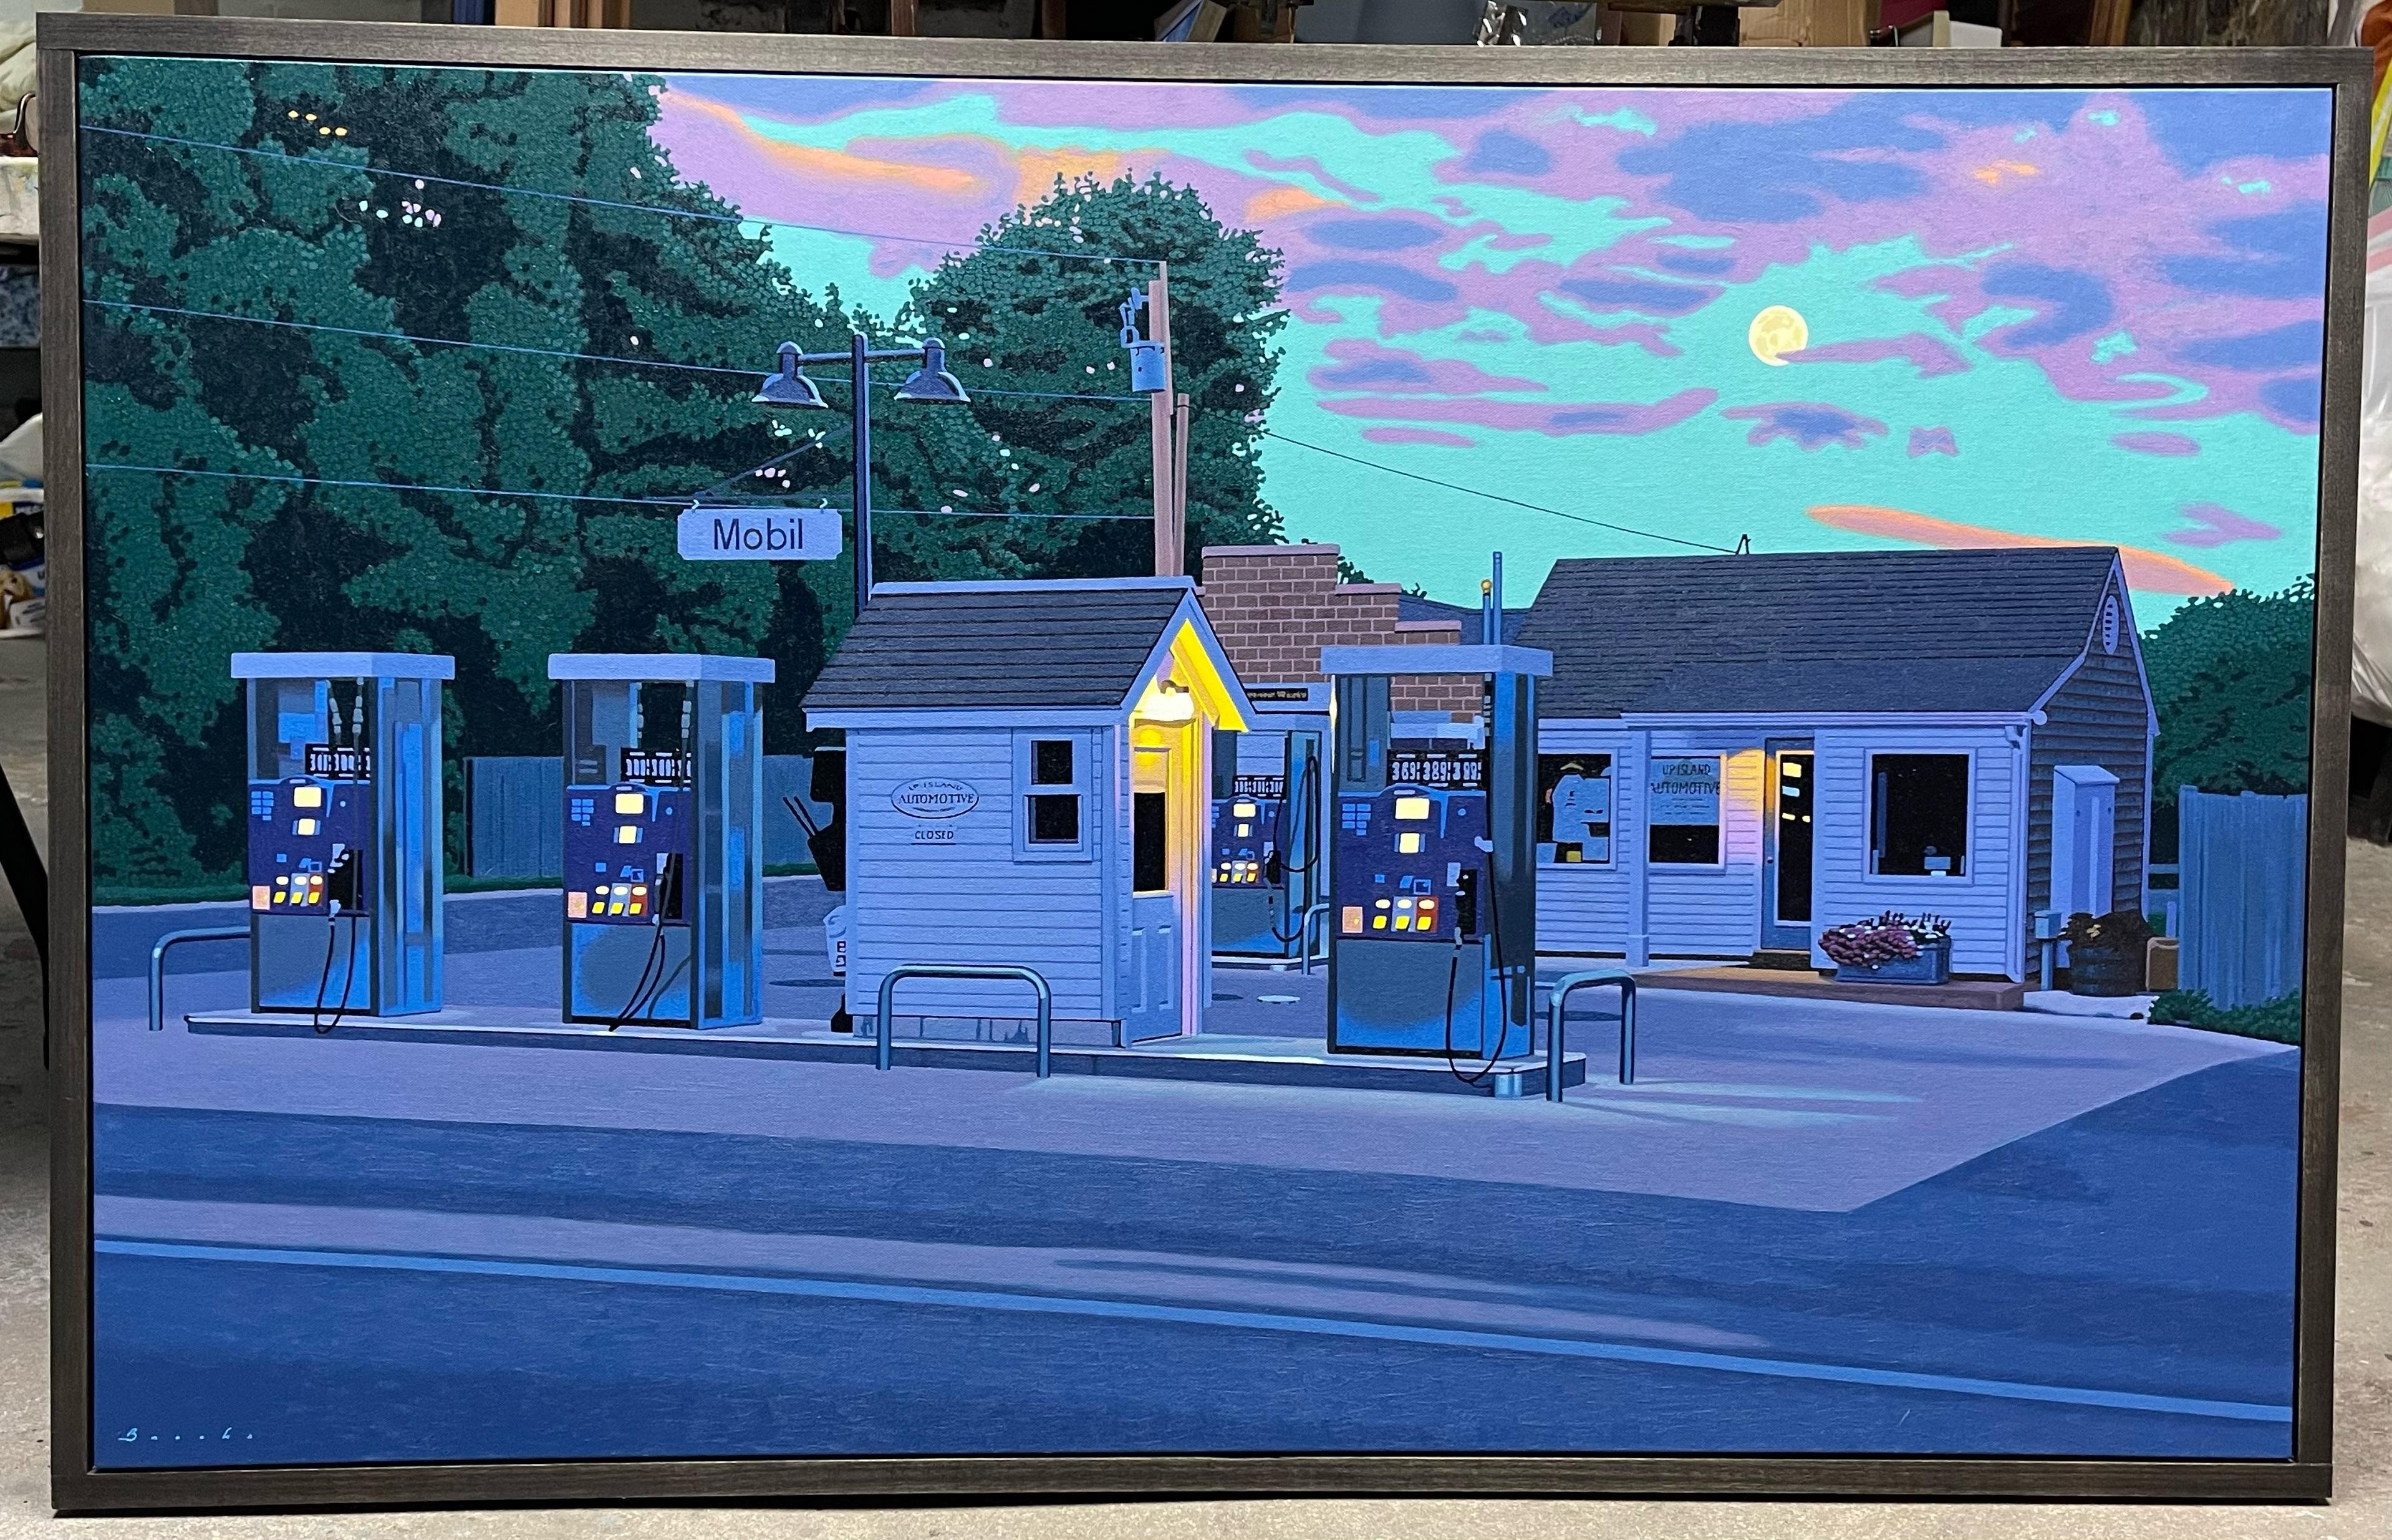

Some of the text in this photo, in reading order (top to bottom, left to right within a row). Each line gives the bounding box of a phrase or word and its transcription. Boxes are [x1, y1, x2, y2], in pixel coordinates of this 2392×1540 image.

[714, 517, 803, 550] Mobil
[899, 793, 975, 804] AUTOMOTIVE
[915, 830, 954, 840] CLOSED
